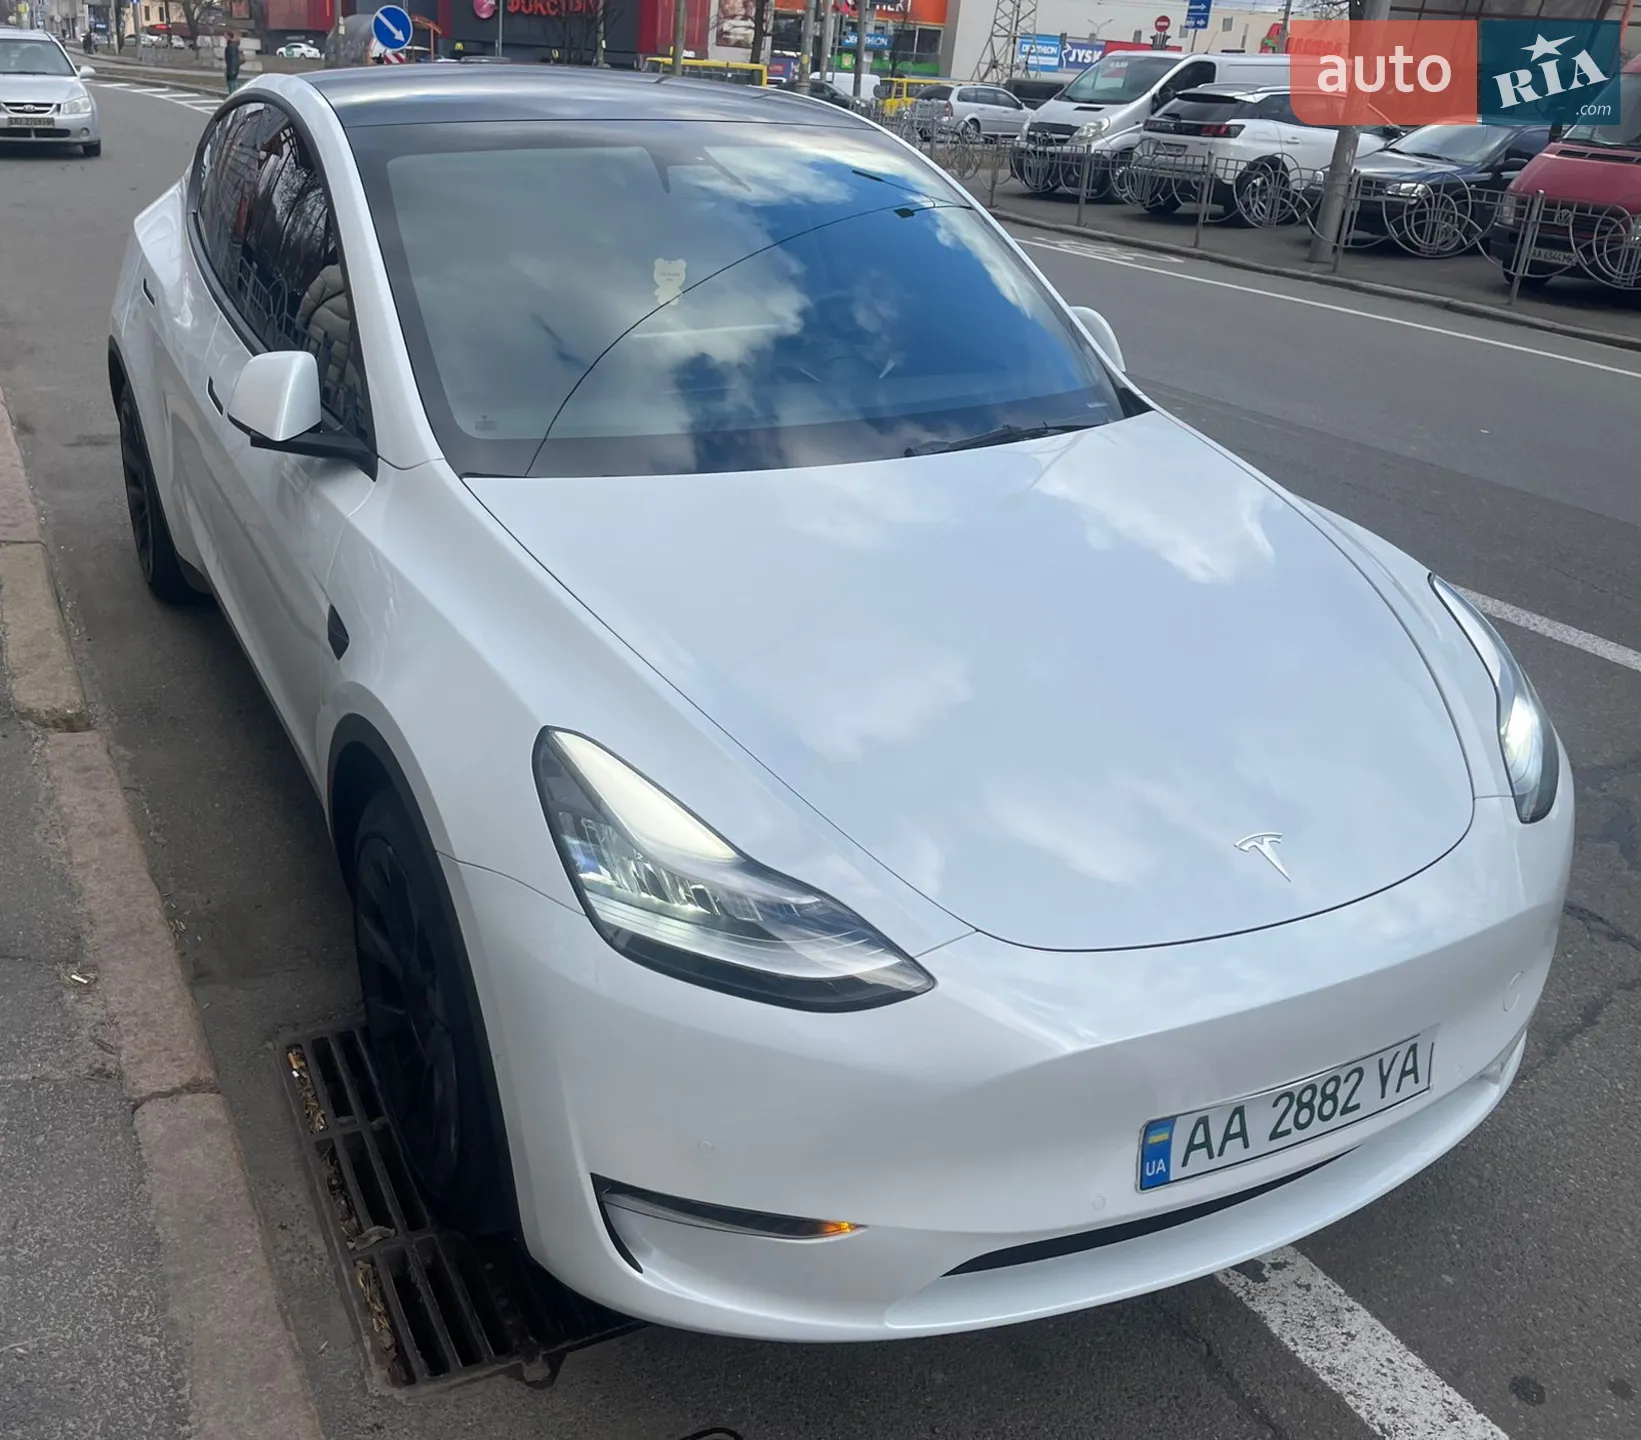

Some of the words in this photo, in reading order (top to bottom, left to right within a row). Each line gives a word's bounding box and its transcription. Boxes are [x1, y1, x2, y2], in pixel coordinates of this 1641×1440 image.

[1068, 48, 1103, 64] JYSK
[1181, 1104, 1249, 1168] AA
[1268, 1066, 1364, 1141] 2882
[1377, 1042, 1419, 1099] YA
[1145, 1157, 1167, 1177] UA
